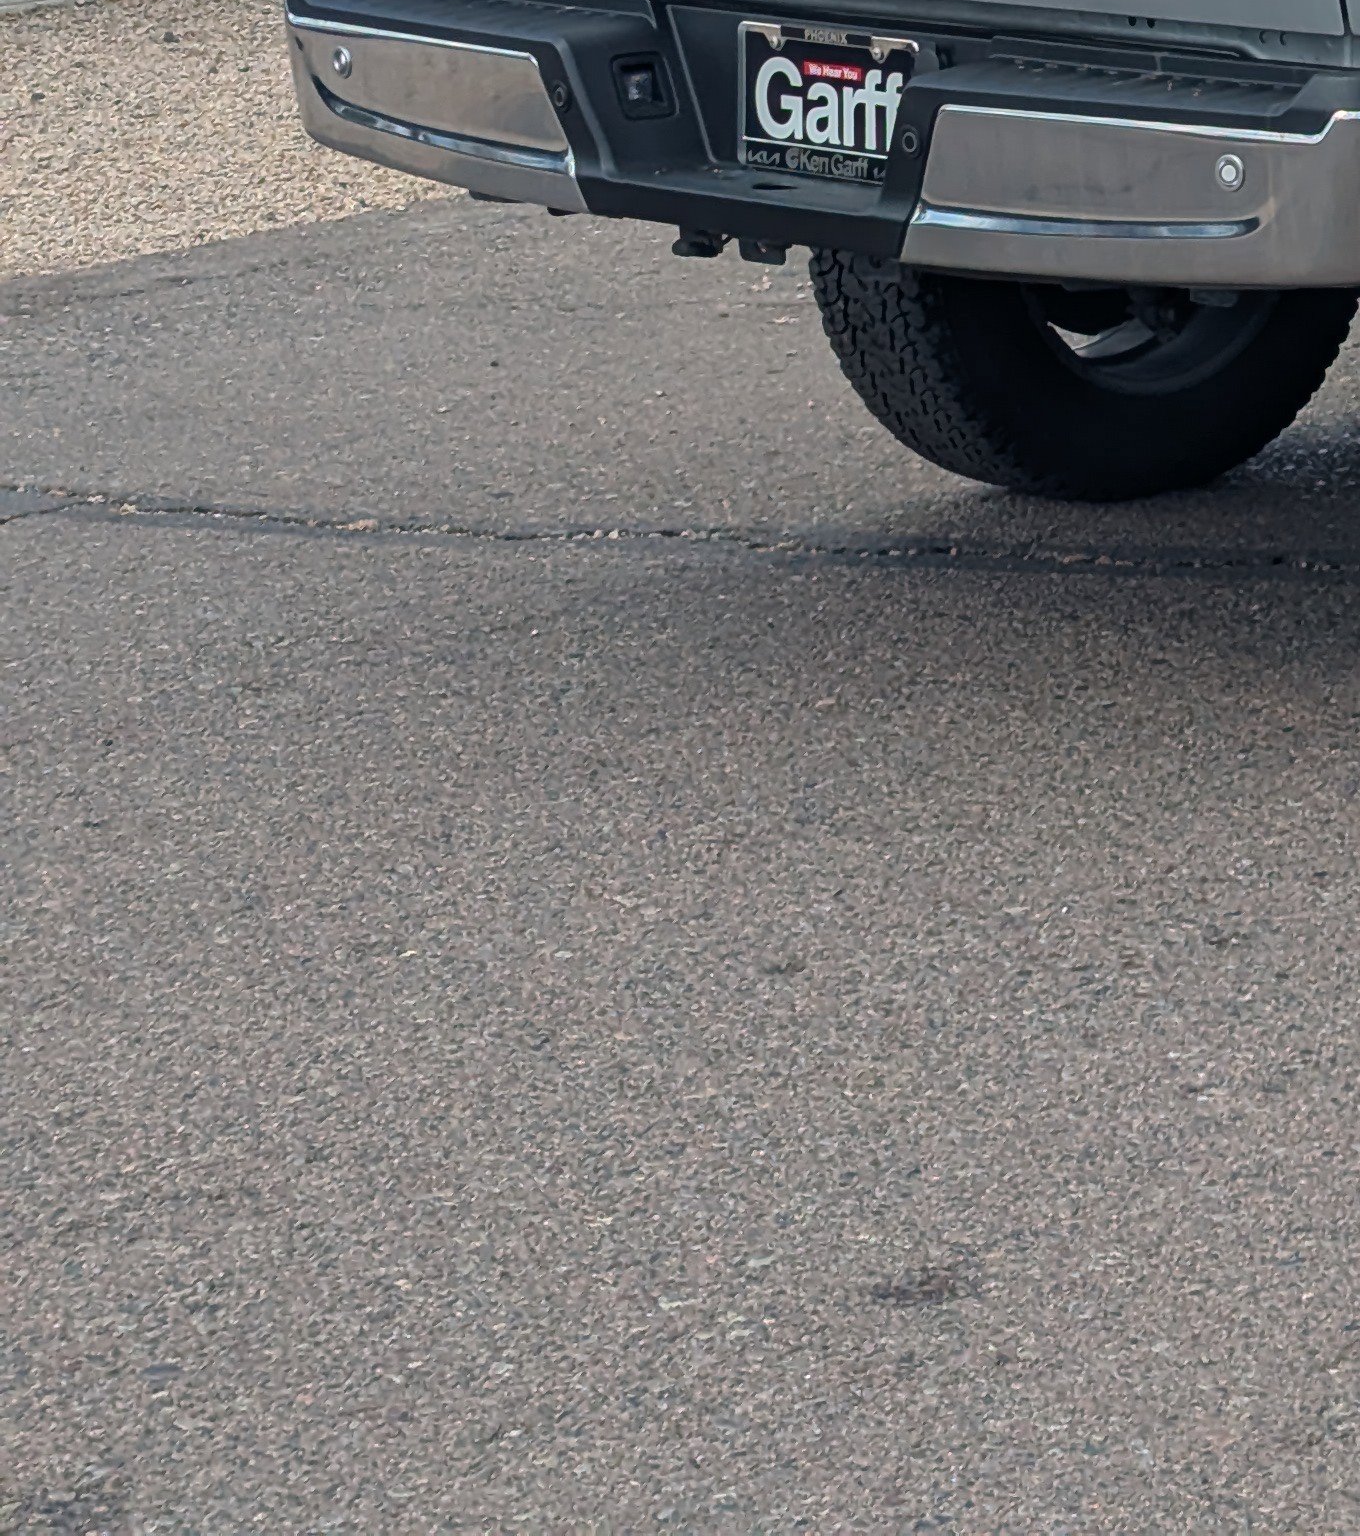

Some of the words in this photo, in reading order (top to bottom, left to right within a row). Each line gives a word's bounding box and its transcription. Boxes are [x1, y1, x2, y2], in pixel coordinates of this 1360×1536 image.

[843, 67, 859, 81] You
[755, 56, 904, 153] Garff
[799, 148, 829, 174] Ken
[830, 154, 869, 178] Garff
